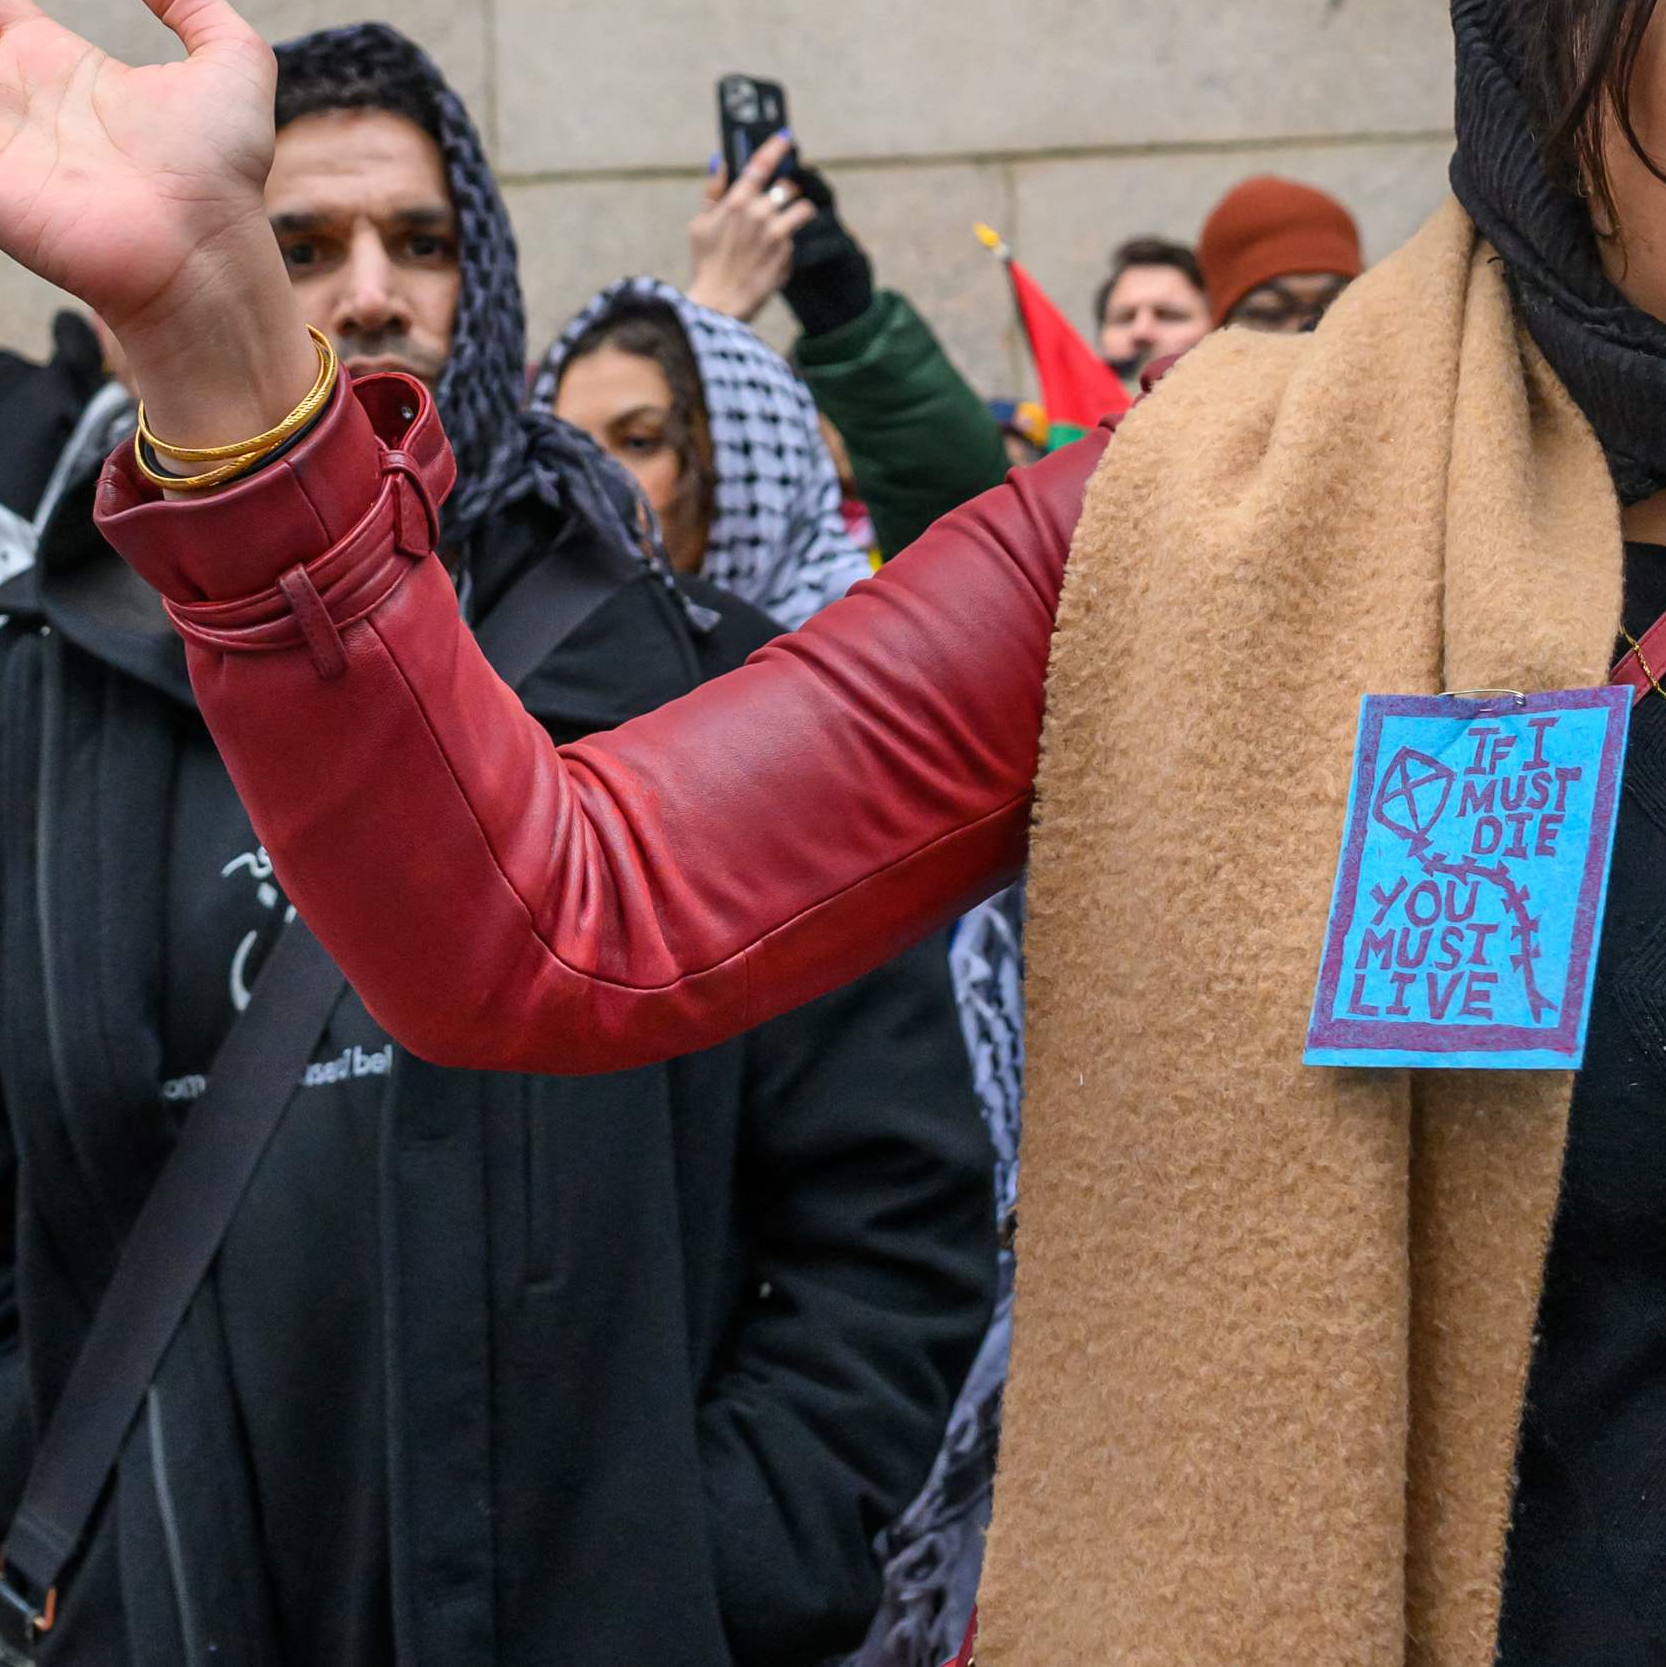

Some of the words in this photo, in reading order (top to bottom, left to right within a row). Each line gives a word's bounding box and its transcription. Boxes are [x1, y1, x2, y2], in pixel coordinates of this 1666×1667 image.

[1463, 726, 1516, 775] IF
[1522, 716, 1561, 771] I
[1455, 766, 1582, 818] MUST
[1470, 813, 1565, 860] DIE
[1369, 875, 1481, 927] YOU
[1355, 923, 1499, 971] MUST
[1346, 970, 1499, 1020] LIVE
